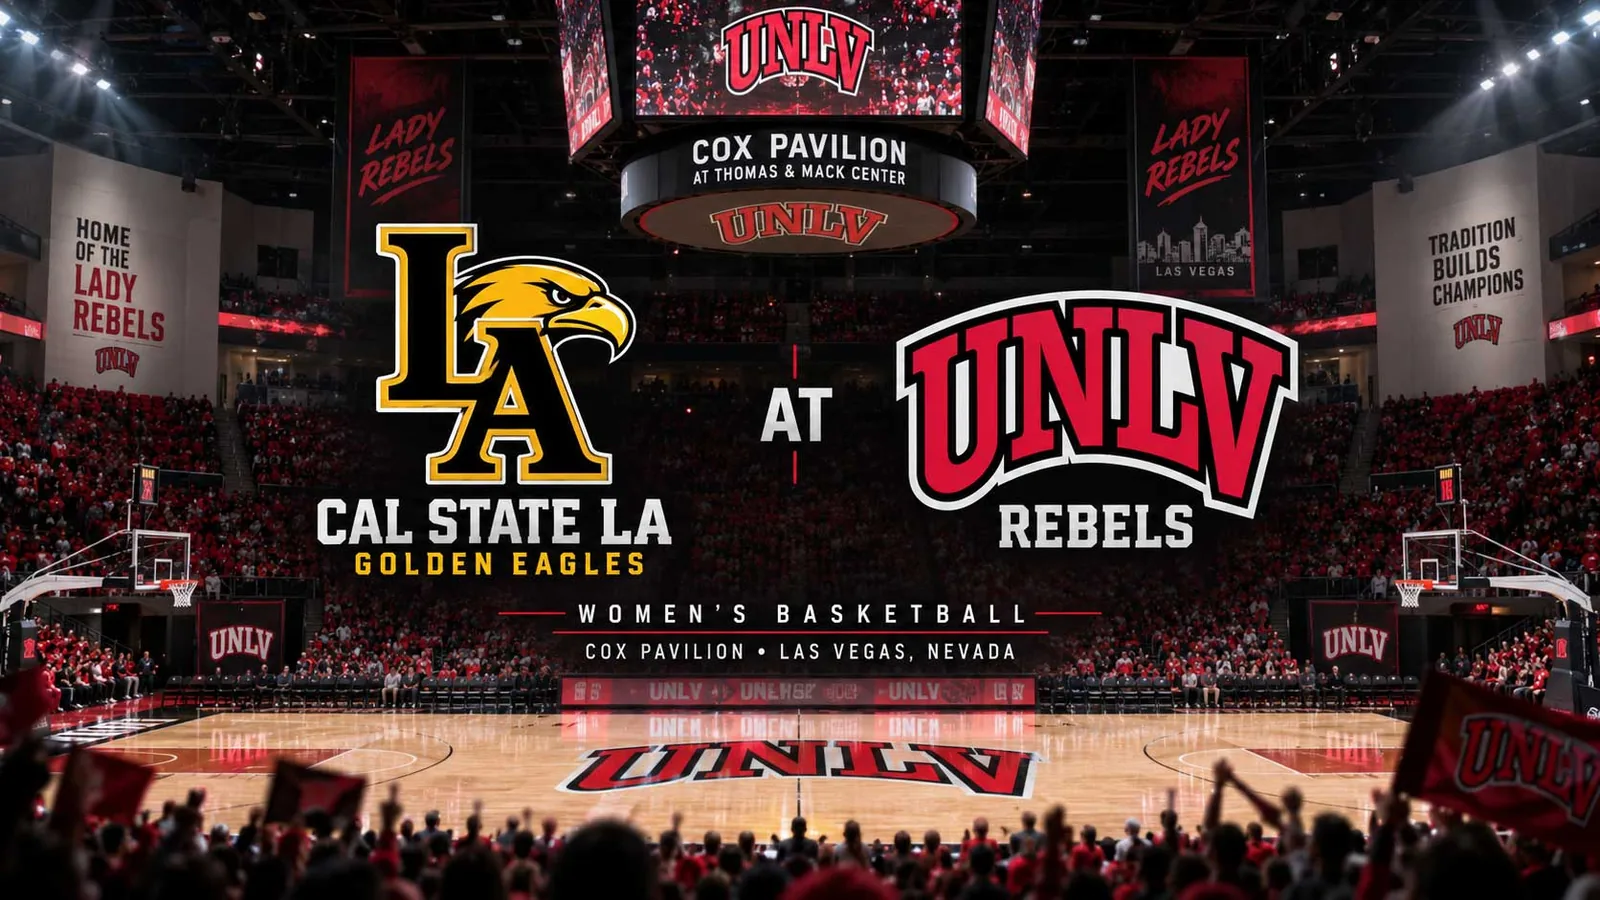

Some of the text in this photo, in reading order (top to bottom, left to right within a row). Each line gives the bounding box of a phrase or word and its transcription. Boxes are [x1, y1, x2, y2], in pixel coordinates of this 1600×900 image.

[721, 7, 875, 96] UNLV
[365, 106, 446, 155] LADY
[692, 133, 906, 166] COX PAVILION
[1151, 107, 1231, 155] LADY
[358, 137, 455, 198] REBELS
[693, 164, 906, 186] AT THOMAS & MACK CENTER
[1145, 137, 1240, 197] REBELS
[76, 217, 131, 248] HOME
[709, 201, 888, 246] UNLV
[1428, 216, 1516, 256] TRADITION
[76, 240, 130, 270] OF THE
[1156, 266, 1235, 277] LAS VEGAS
[1433, 245, 1501, 281] BUILDS
[74, 263, 138, 304] LADY
[1433, 268, 1524, 307] CHAMPIONS
[73, 299, 165, 342] REBELS
[1453, 313, 1503, 350] UNLV
[95, 346, 140, 379] UNLV
[209, 625, 274, 662] UNLV
[1322, 625, 1389, 661] UNLV
[650, 682, 702, 701] UNLV
[888, 682, 940, 701] UNLV
[555, 739, 1044, 799] UNLV
[1455, 713, 1600, 828] UNLV
